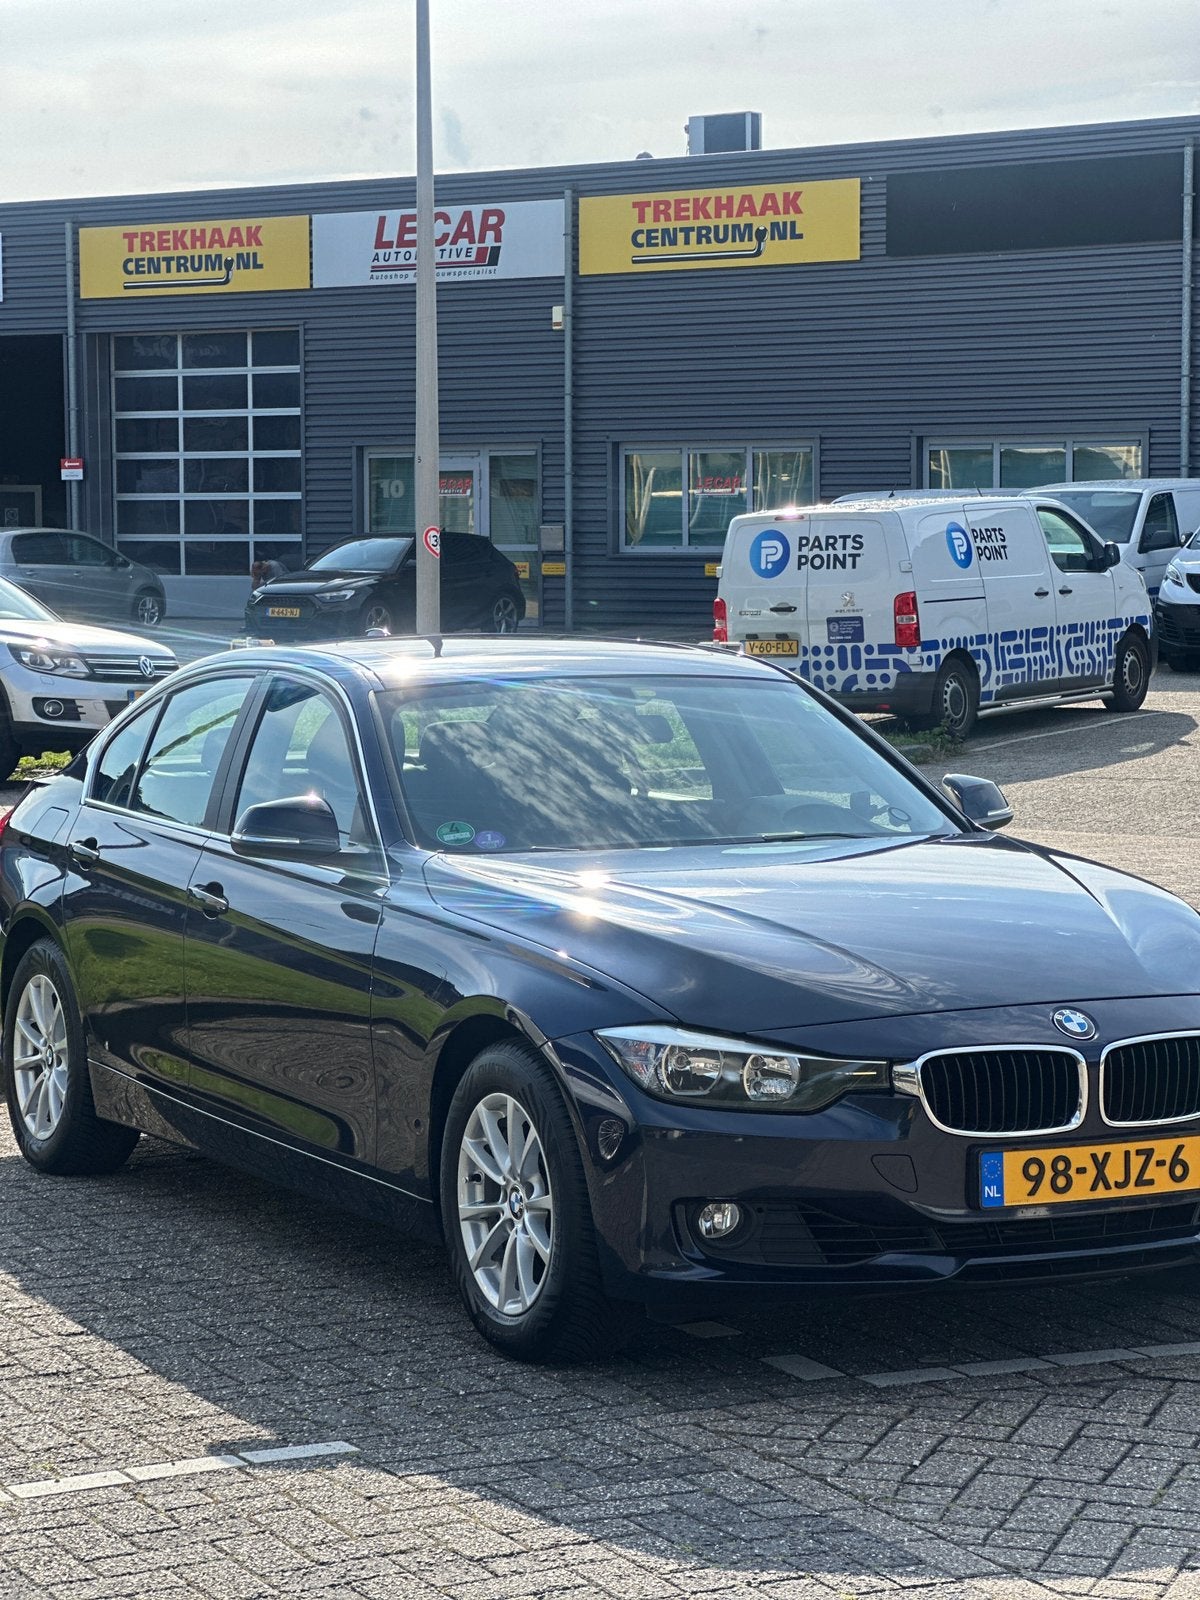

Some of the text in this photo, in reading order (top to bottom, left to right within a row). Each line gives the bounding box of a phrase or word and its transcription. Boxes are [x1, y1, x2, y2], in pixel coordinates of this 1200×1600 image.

[631, 191, 804, 224] TREKHAAK
[373, 208, 506, 250] LECAR
[123, 225, 264, 253] TREKHAAK
[372, 247, 473, 263] AUTOTIVE
[369, 273, 409, 281] Autoshop
[436, 268, 497, 278] ouwspecialist
[380, 479, 405, 498] 10
[439, 478, 472, 490] ECAR
[798, 534, 864, 552] PARTS
[970, 527, 1006, 543] PARTS
[976, 545, 1008, 561] POINT
[797, 553, 861, 570] POINT
[749, 642, 794, 654] V-60-FLX
[1022, 1144, 1190, 1197] 98-XJZ-6
[984, 1185, 1001, 1198] NL
